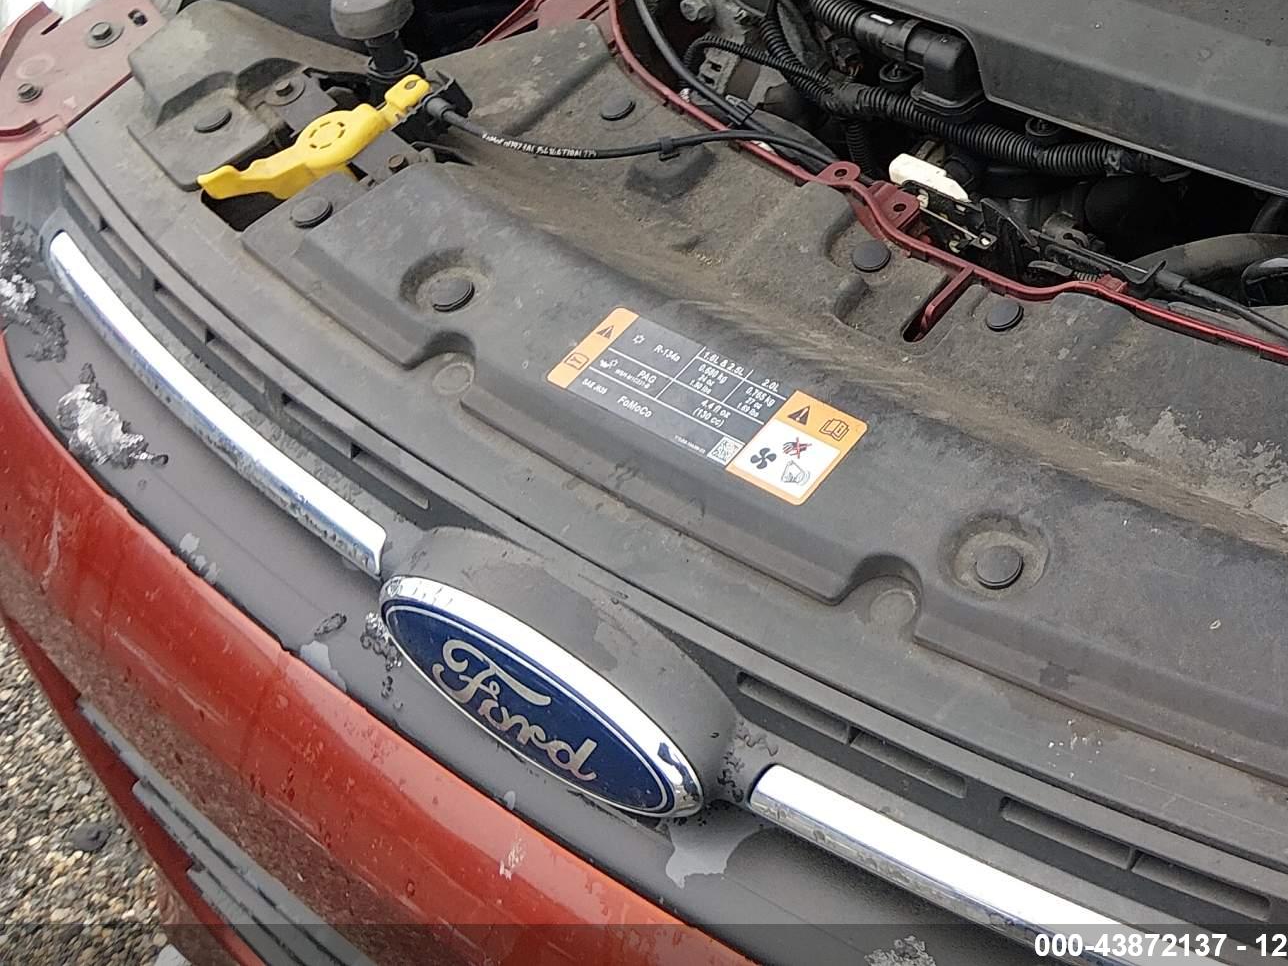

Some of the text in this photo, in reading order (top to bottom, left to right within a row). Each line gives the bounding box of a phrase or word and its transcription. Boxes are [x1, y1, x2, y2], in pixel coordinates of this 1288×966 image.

[653, 344, 681, 362] R-134a
[637, 370, 657, 383] PAG
[717, 373, 728, 384] kg
[761, 378, 780, 392] 2.0L
[745, 386, 776, 407] 0.765 kg
[617, 395, 652, 418] FoMoCo
[701, 400, 714, 409] 4.4
[720, 409, 731, 419] oz
[692, 407, 725, 428] (130 cc)
[432, 638, 598, 782] Ford
